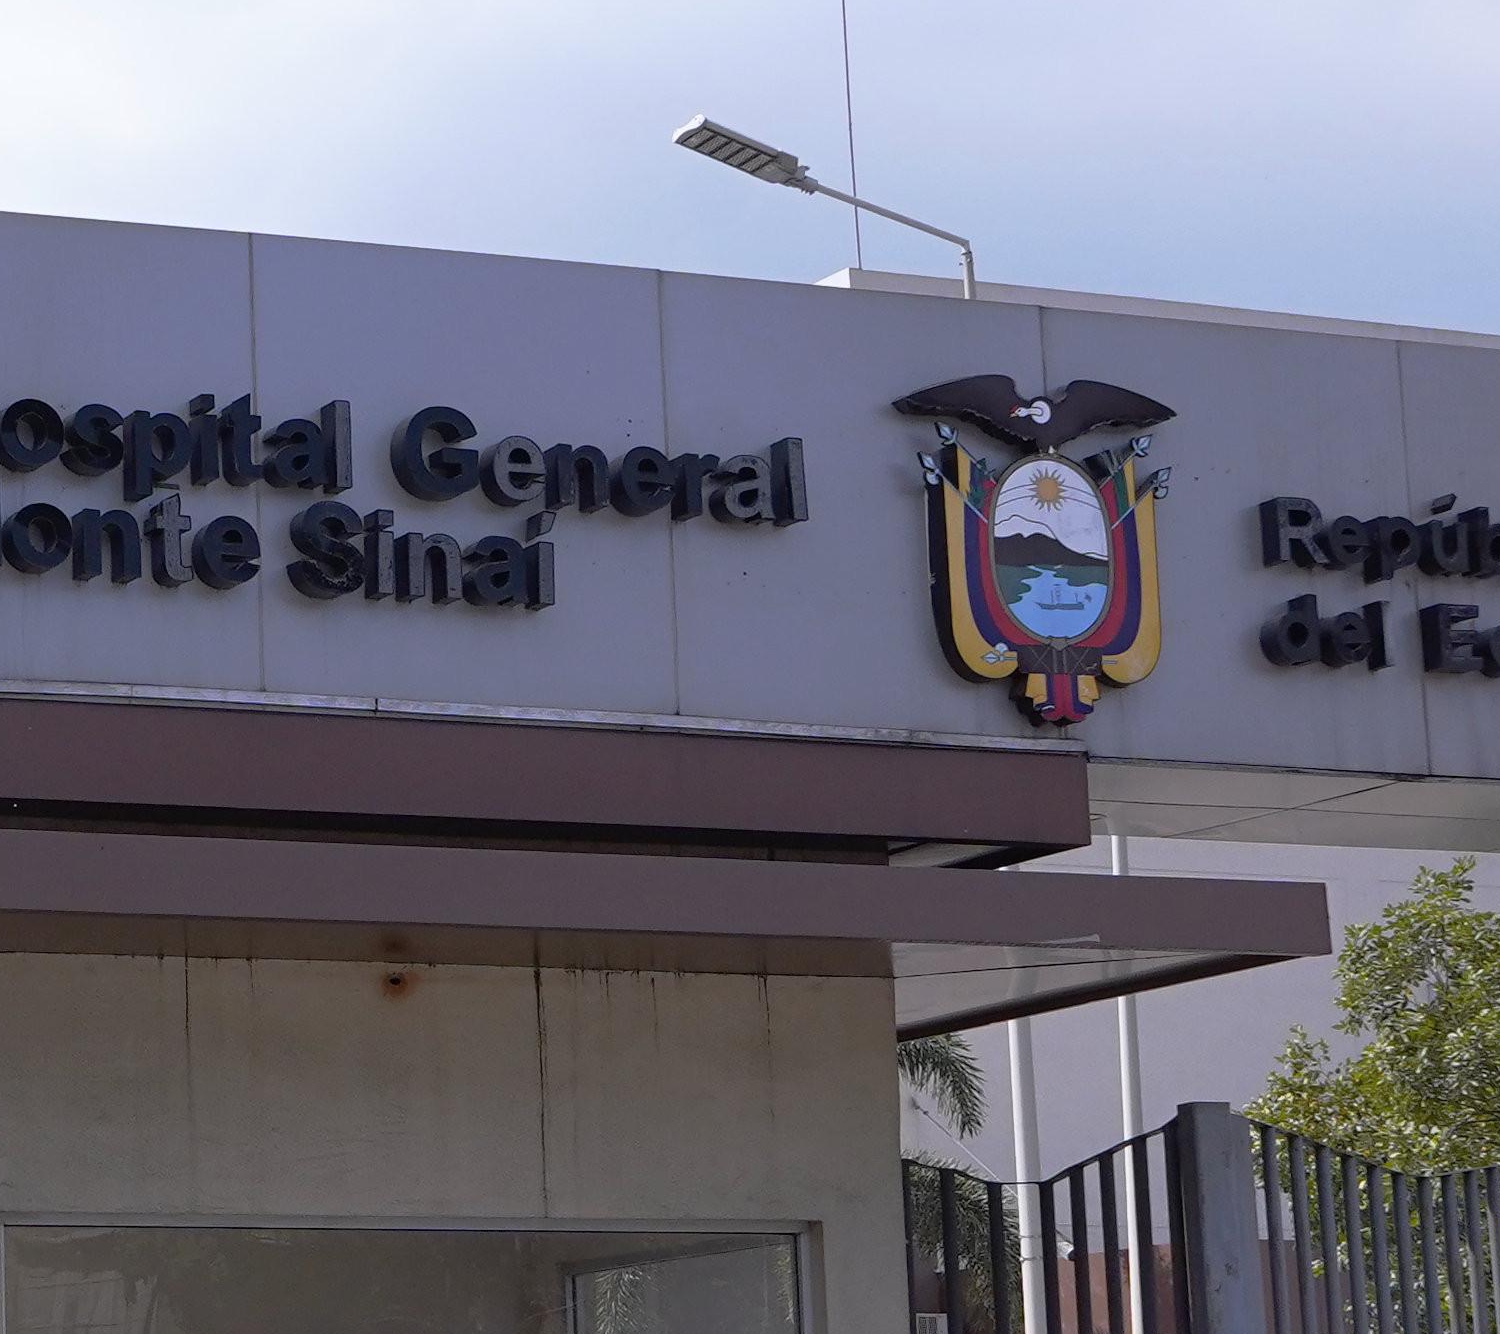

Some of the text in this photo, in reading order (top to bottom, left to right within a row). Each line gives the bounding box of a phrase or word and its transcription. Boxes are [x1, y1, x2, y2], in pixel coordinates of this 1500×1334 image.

[389, 405, 808, 528] General
[285, 500, 557, 612] Sinaí
[1259, 594, 1392, 671] del
